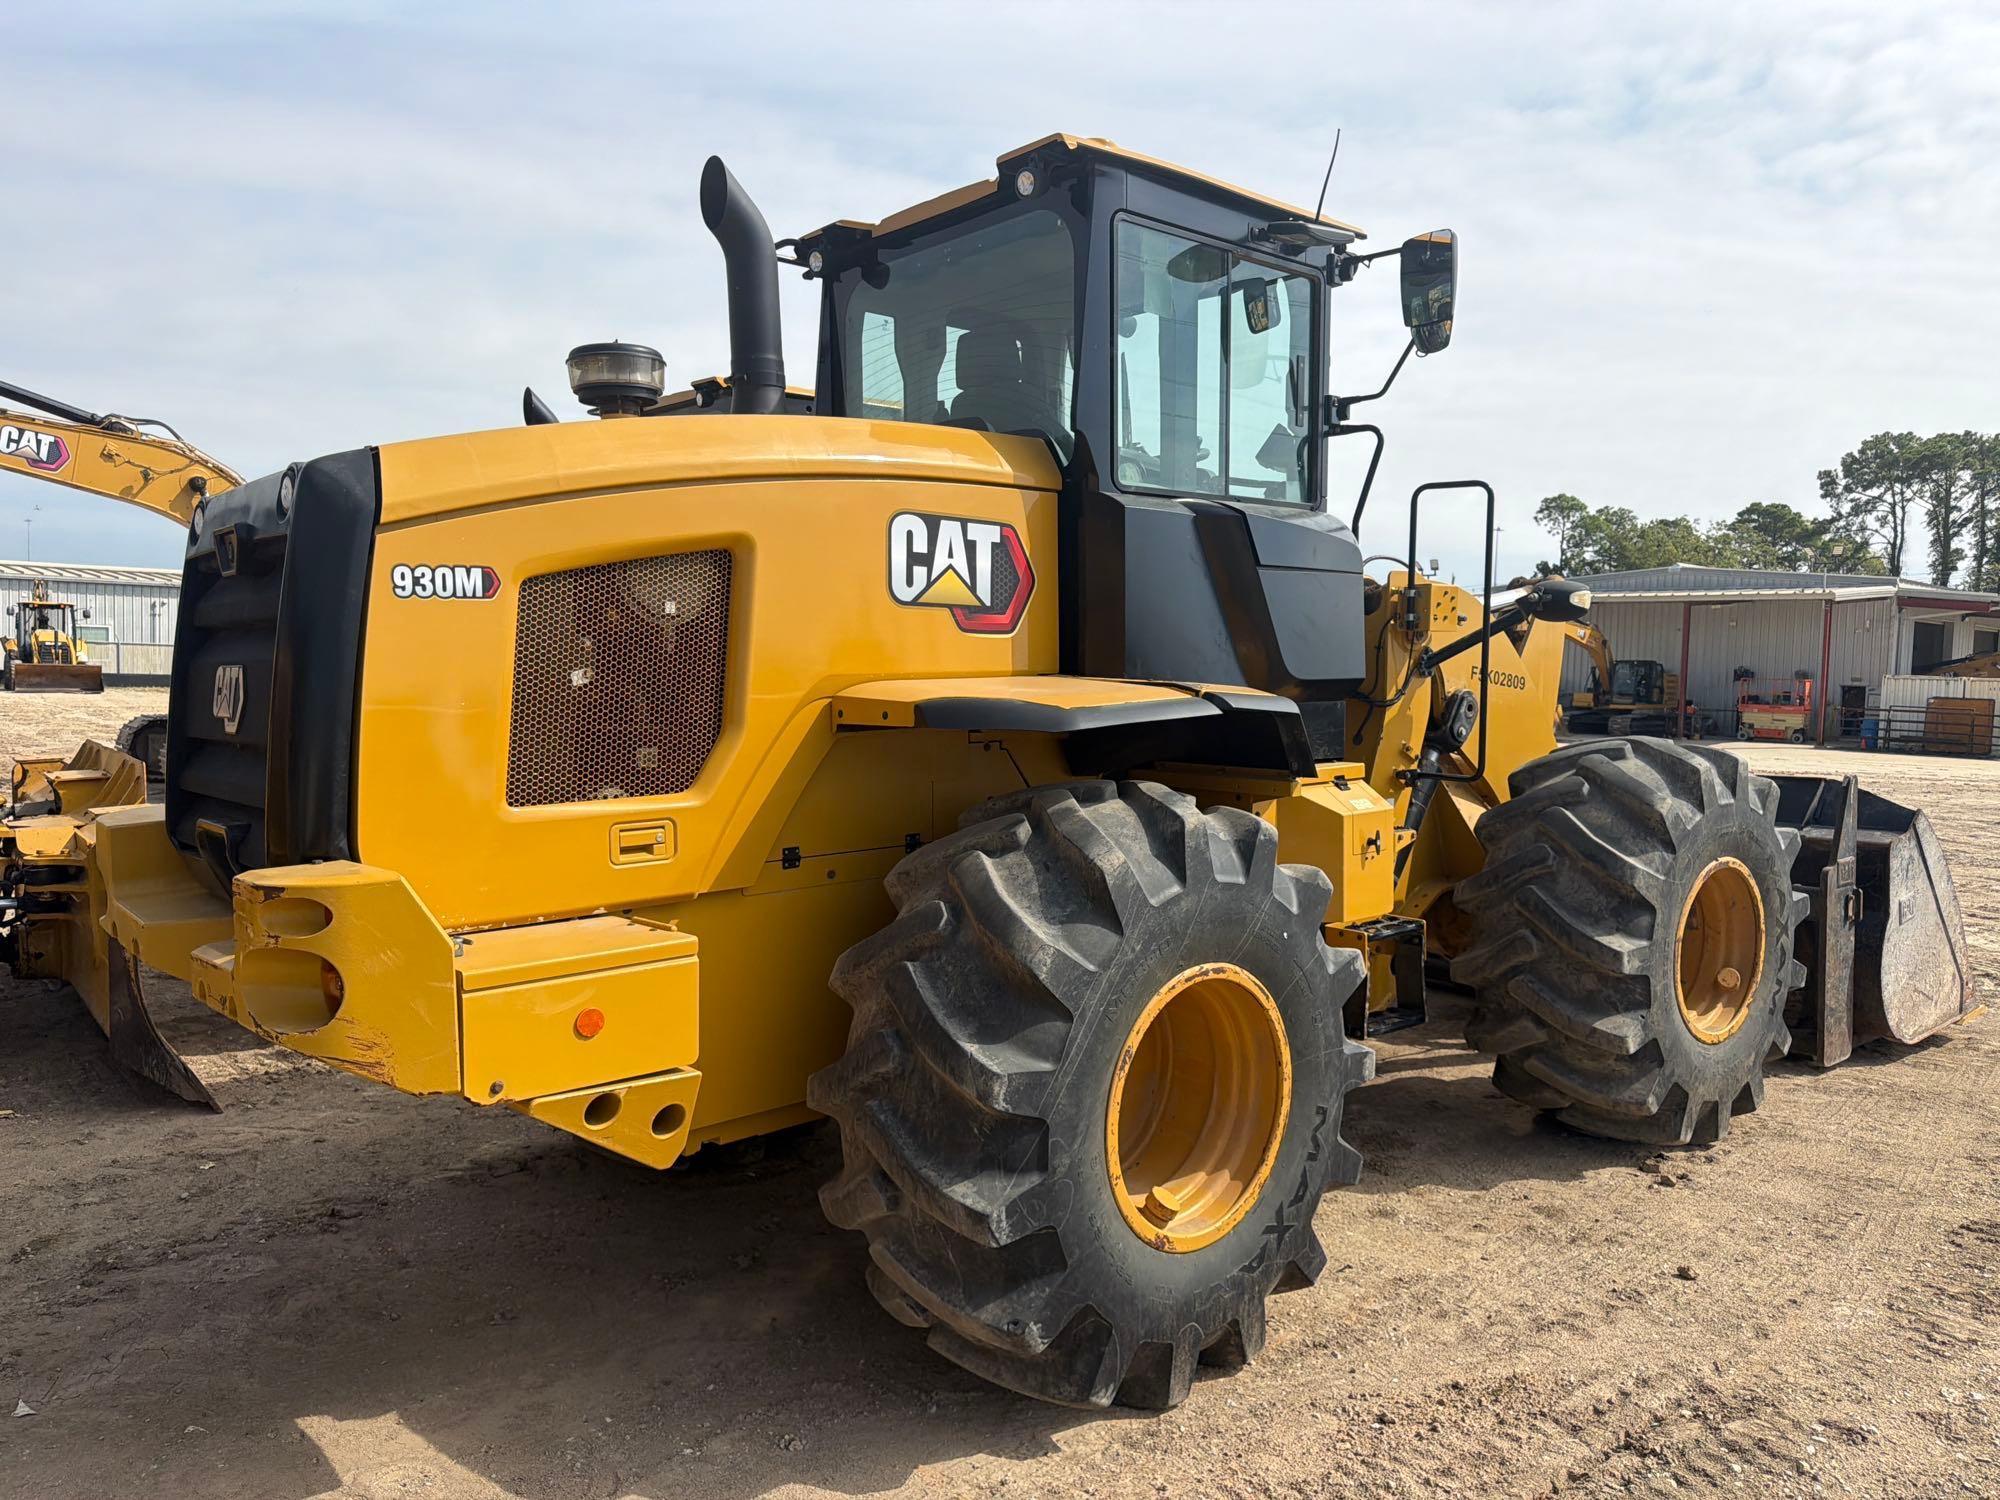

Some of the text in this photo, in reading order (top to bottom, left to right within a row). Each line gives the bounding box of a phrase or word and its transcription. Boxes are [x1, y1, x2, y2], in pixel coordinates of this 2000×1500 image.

[0, 425, 55, 462] CAT
[393, 565, 483, 598] 930M
[890, 513, 1001, 607] CAT
[213, 666, 239, 719] CAT
